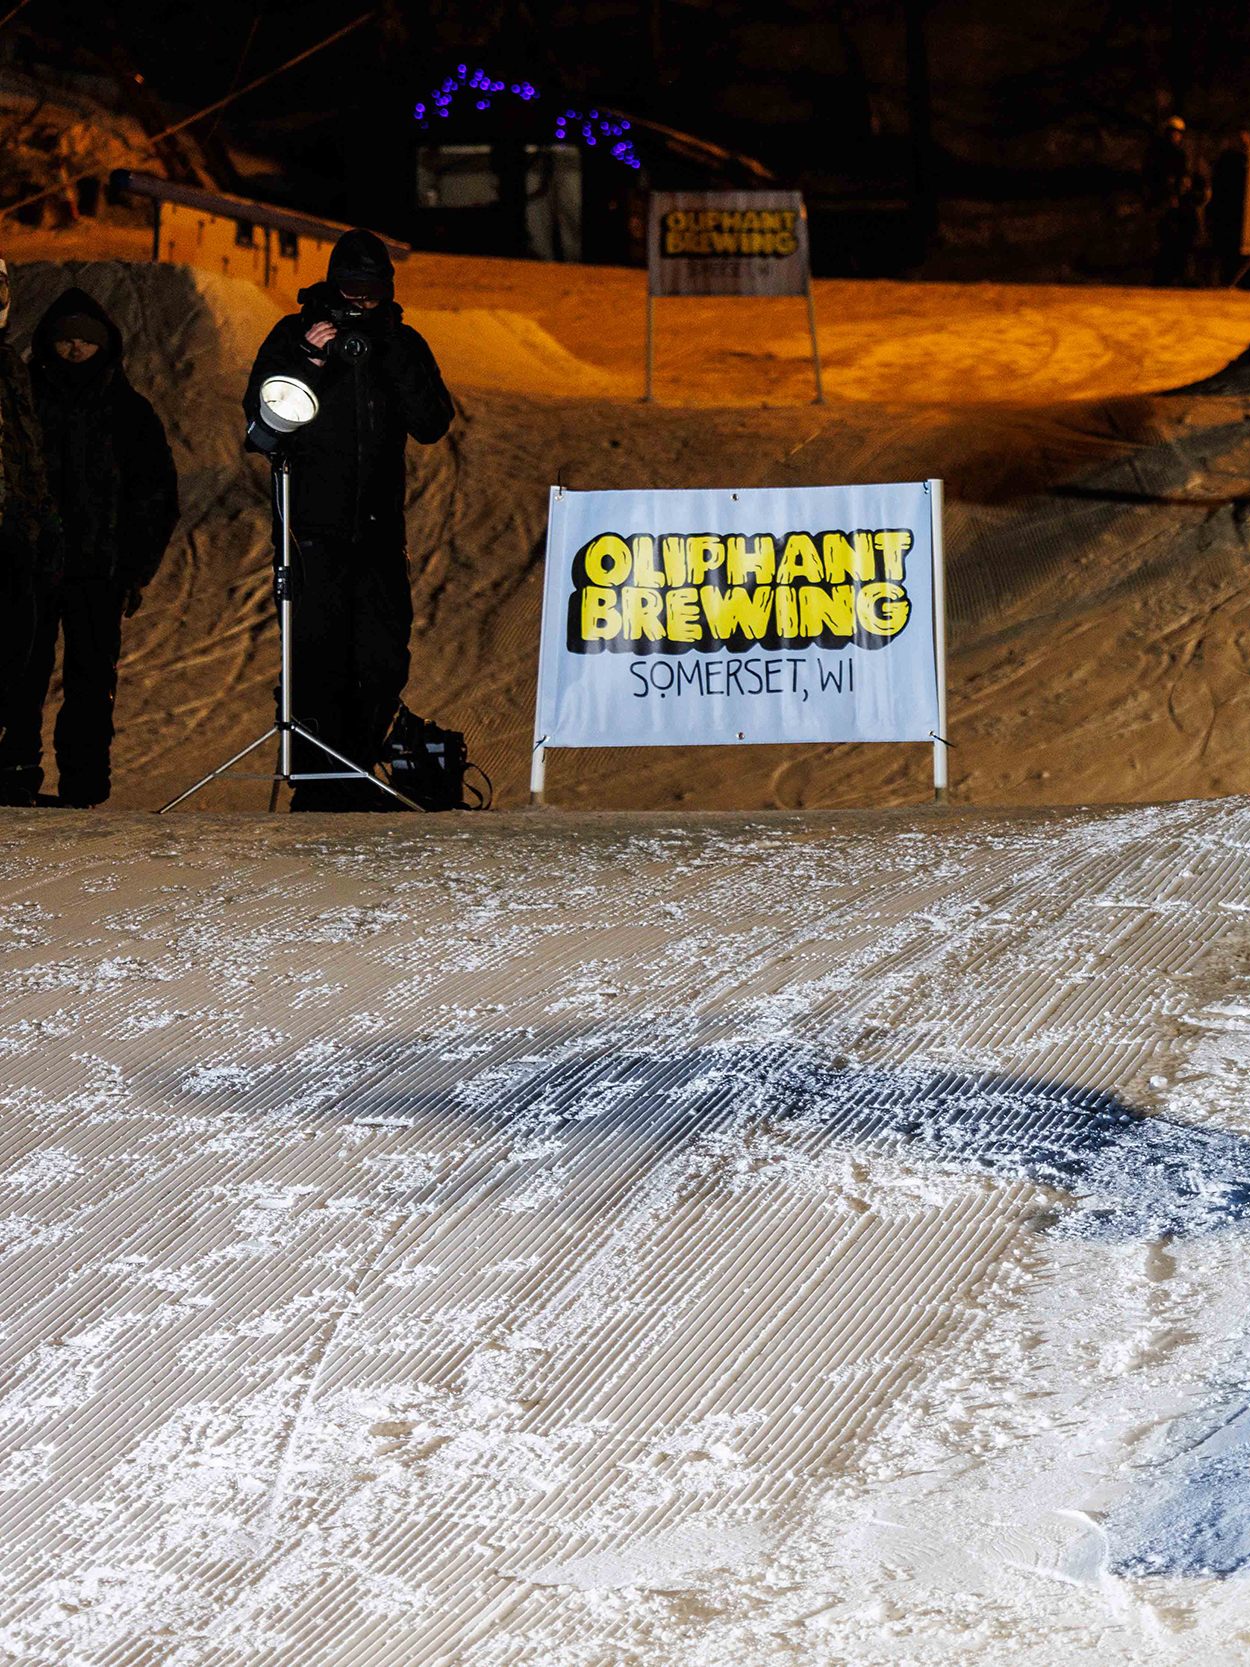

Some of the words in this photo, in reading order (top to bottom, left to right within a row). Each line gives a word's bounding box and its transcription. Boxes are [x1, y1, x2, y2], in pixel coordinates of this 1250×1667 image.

[665, 211, 796, 233] OLIPHANT
[665, 231, 797, 255] BREWING
[578, 530, 913, 589] OLIPHANT
[576, 582, 912, 646] BREWING
[629, 658, 809, 702] SOMERSET,
[818, 658, 853, 694] WI
